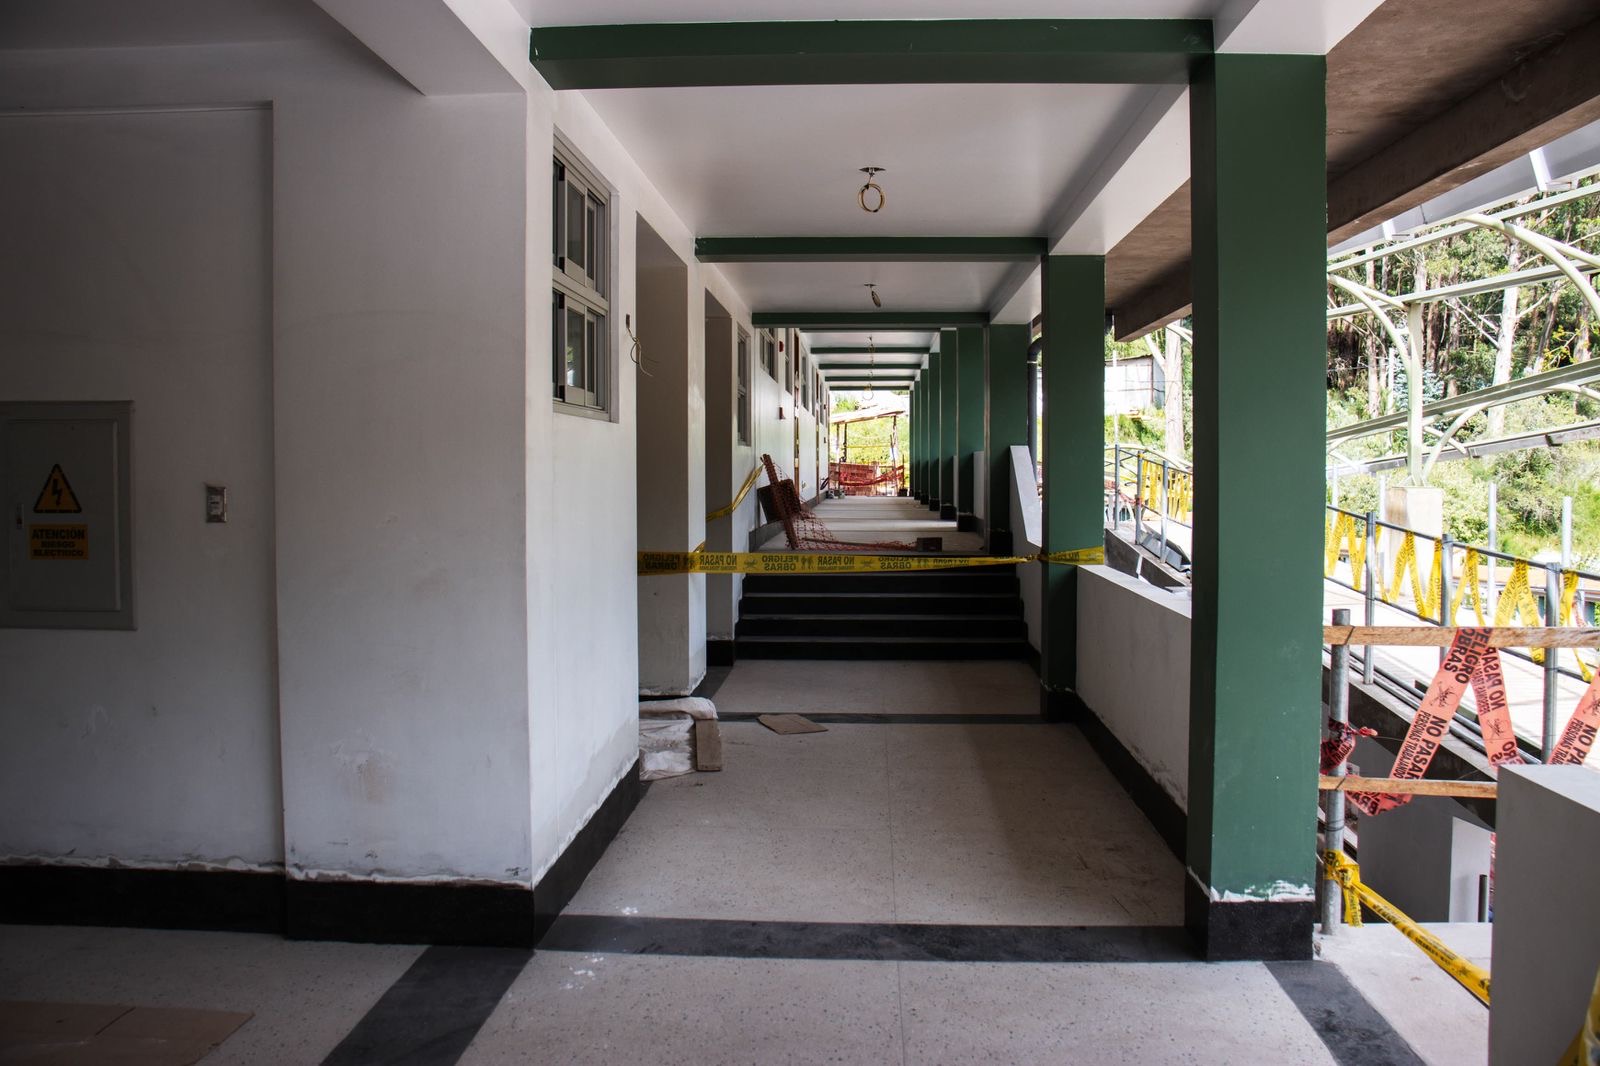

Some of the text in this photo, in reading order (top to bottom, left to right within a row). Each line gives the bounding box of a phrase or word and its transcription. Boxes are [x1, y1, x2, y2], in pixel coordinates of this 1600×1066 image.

[31, 527, 85, 539] ATENCIÓN
[1444, 629, 1475, 673] OBRAS
[1425, 715, 1448, 738] NO
[1561, 718, 1585, 749] PERSONAS
[1578, 724, 1598, 746] NO
[1394, 710, 1431, 779] PERSONAS TRABAJANDO
